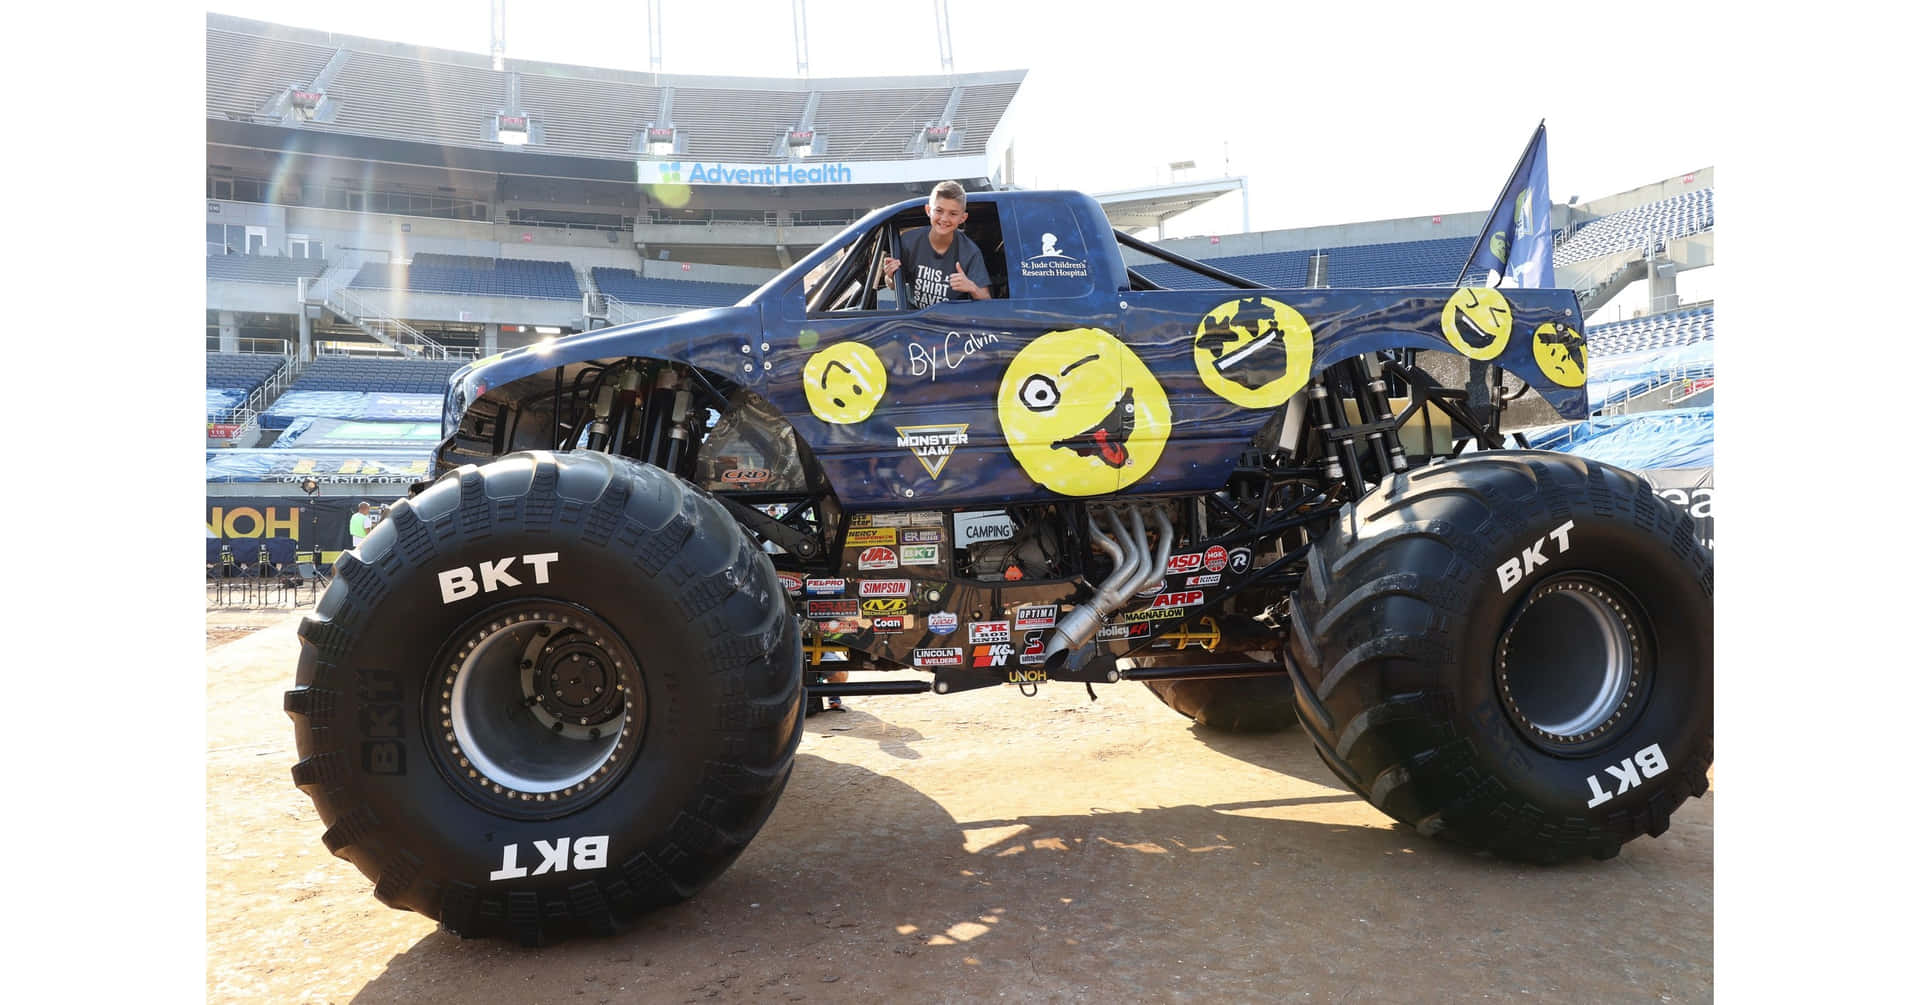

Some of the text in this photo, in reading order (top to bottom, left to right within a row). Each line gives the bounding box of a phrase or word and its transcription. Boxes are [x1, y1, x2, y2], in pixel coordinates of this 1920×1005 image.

[689, 162, 851, 185] AdventHealth
[1031, 261, 1048, 270] Jude
[917, 264, 943, 283] THIS
[1022, 269, 1087, 278] Research Hospital
[914, 278, 950, 297] SHIRT
[908, 331, 1000, 382] By Calvin
[896, 433, 969, 448] MONSTER
[917, 445, 951, 456] JAM
[966, 524, 1010, 538] CAMPING
[861, 548, 895, 561] JAZ
[903, 547, 936, 559] BKT
[1497, 519, 1574, 594] BKT
[1168, 554, 1201, 568] MSD
[438, 552, 559, 604] BKT
[863, 583, 906, 593] SIMPSON
[1153, 592, 1203, 606] ARP
[1019, 608, 1053, 619] OPTIMA
[1125, 609, 1183, 622] MAGNAFLOW
[873, 618, 901, 628] Coan
[915, 649, 954, 658] LINCOLN
[924, 657, 958, 665] WELDERS
[1008, 671, 1047, 683] UNOH
[1586, 743, 1671, 809] BKT
[490, 836, 610, 881] BKT
